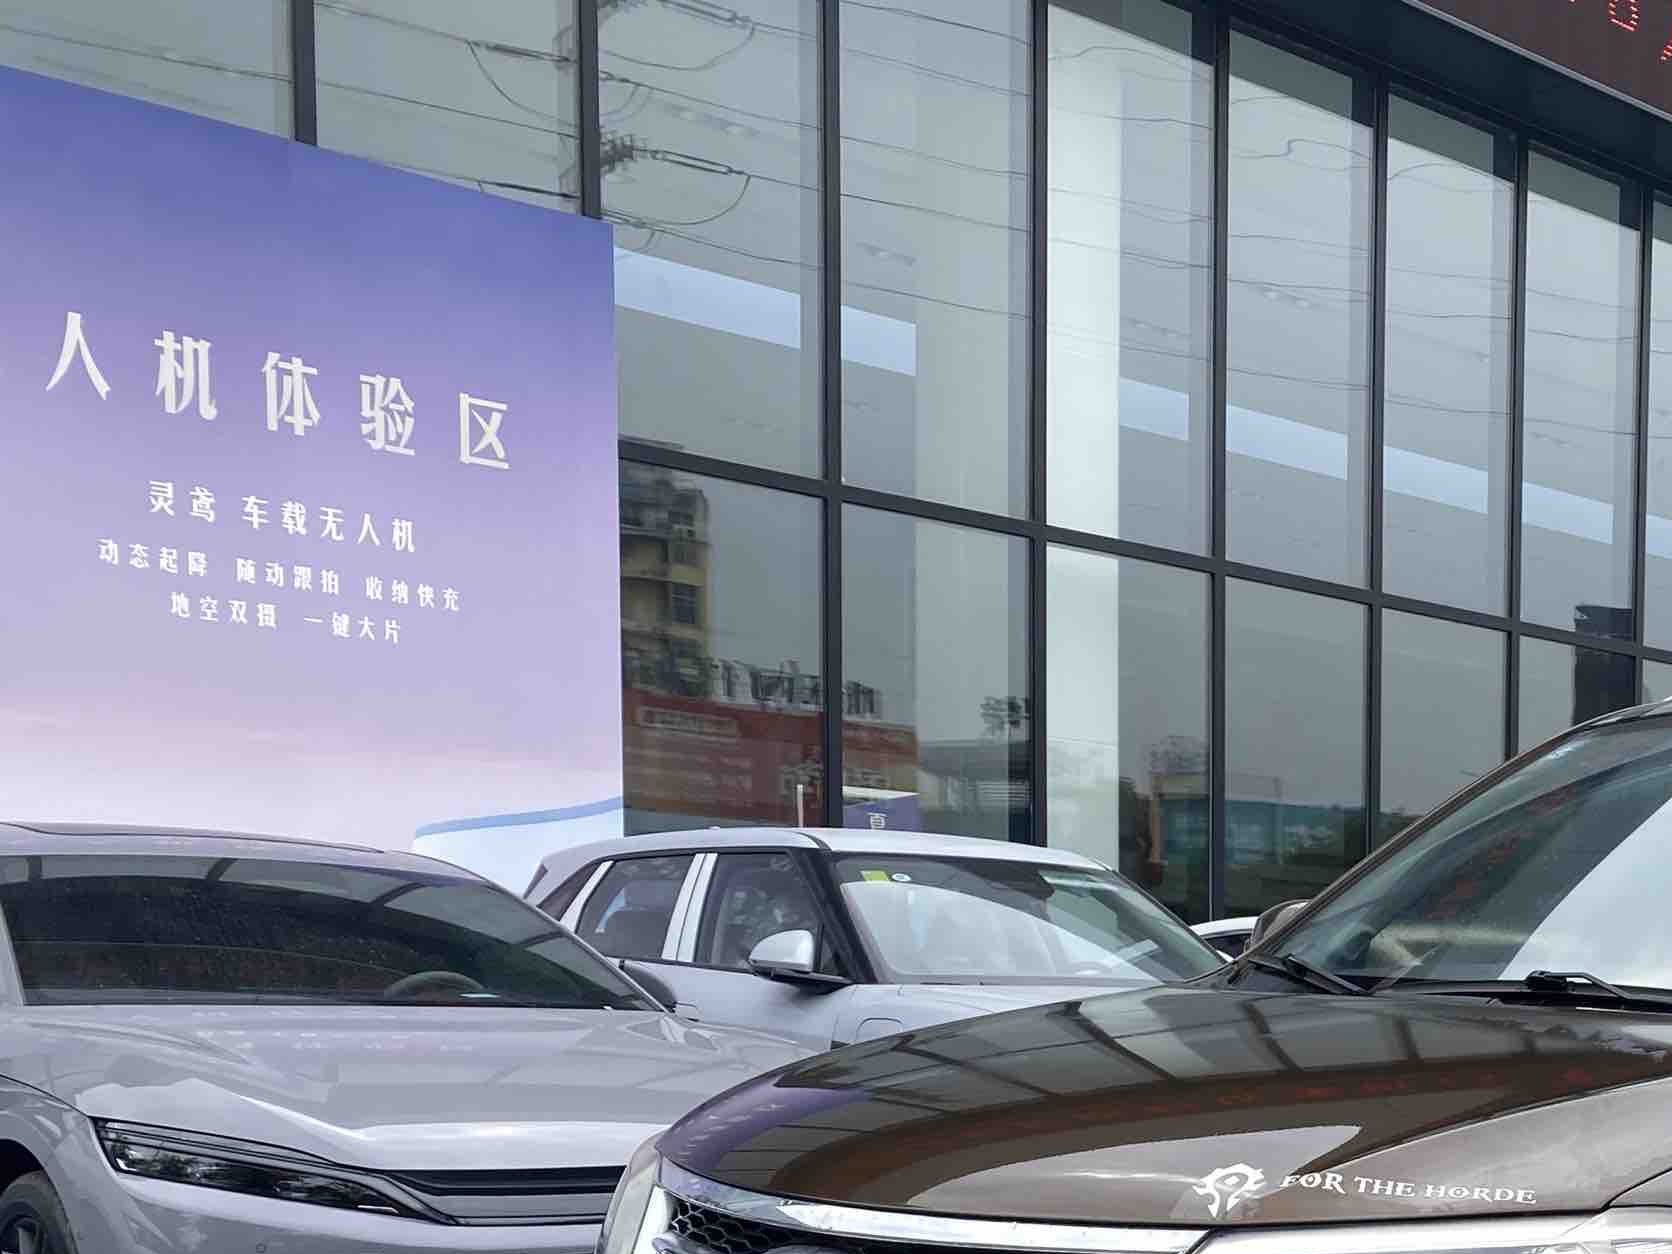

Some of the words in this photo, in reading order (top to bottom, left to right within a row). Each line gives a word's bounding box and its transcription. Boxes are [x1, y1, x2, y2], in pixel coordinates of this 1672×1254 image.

[46, 311, 510, 470] 人机体验区
[149, 480, 216, 523] 灵鸢
[241, 495, 416, 553] 车载无人机
[98, 538, 209, 577] 动态起降
[364, 576, 461, 612] 收纳快充
[303, 611, 402, 645] 一键大片
[1279, 1172, 1347, 1195] FOR
[1353, 1176, 1416, 1198] THE
[1424, 1183, 1538, 1205] HORDE
